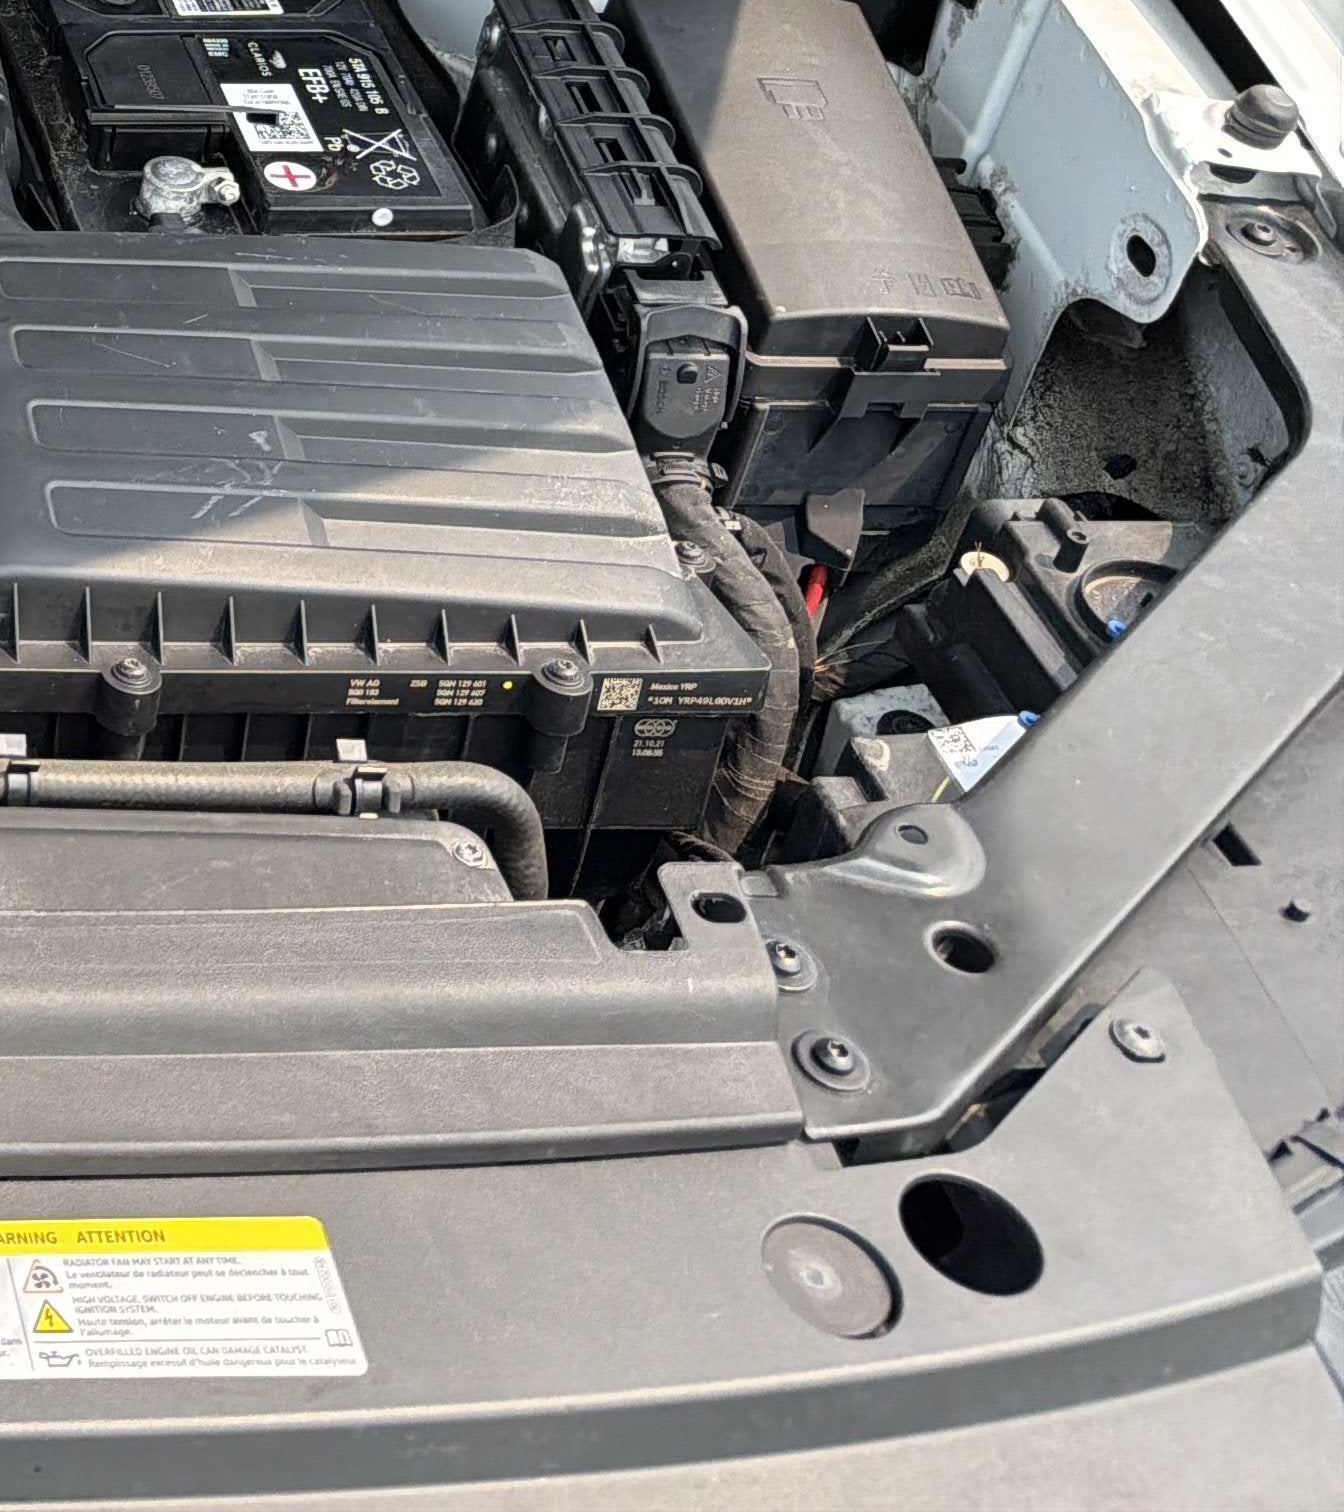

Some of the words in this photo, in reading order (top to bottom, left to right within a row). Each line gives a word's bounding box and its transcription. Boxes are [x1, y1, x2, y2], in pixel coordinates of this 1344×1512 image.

[247, 41, 273, 76] CLARIOS
[348, 58, 368, 73] 5TA
[297, 68, 330, 104] EFB+
[356, 73, 377, 89] 915
[323, 136, 345, 152] Pb
[350, 679, 365, 687] VW
[366, 679, 380, 687] AG
[409, 679, 428, 687] ZSB
[458, 680, 472, 688] 129
[680, 683, 698, 691] YRP
[76, 1229, 166, 1244] ATTENTION
[63, 1258, 109, 1267] RADIATOR
[111, 1257, 130, 1266] FAN
[132, 1257, 151, 1266] MAY
[153, 1256, 181, 1266] START
[183, 1256, 194, 1266] AT
[195, 1256, 214, 1266] ANY
[65, 1270, 77, 1279] Le
[79, 1269, 131, 1279] ventilateur
[132, 1269, 145, 1278] de
[146, 1269, 189, 1278] radiateur
[214, 1270, 226, 1278] se
[72, 1295, 96, 1304] HIGH
[143, 1295, 179, 1304] SWITCH
[180, 1294, 198, 1303] OFF
[200, 1294, 235, 1303] ENGINE
[236, 1293, 273, 1302] BEFORE
[274, 1292, 323, 1302] TOUCHING
[75, 1305, 118, 1314] IGNITION
[0, 1337, 23, 1346] dans
[85, 1348, 143, 1357] OVERFILLED
[144, 1347, 180, 1356] ENGINE
[182, 1347, 198, 1355] OIL
[199, 1346, 220, 1355] CAN
[221, 1345, 261, 1355] DAMAGE
